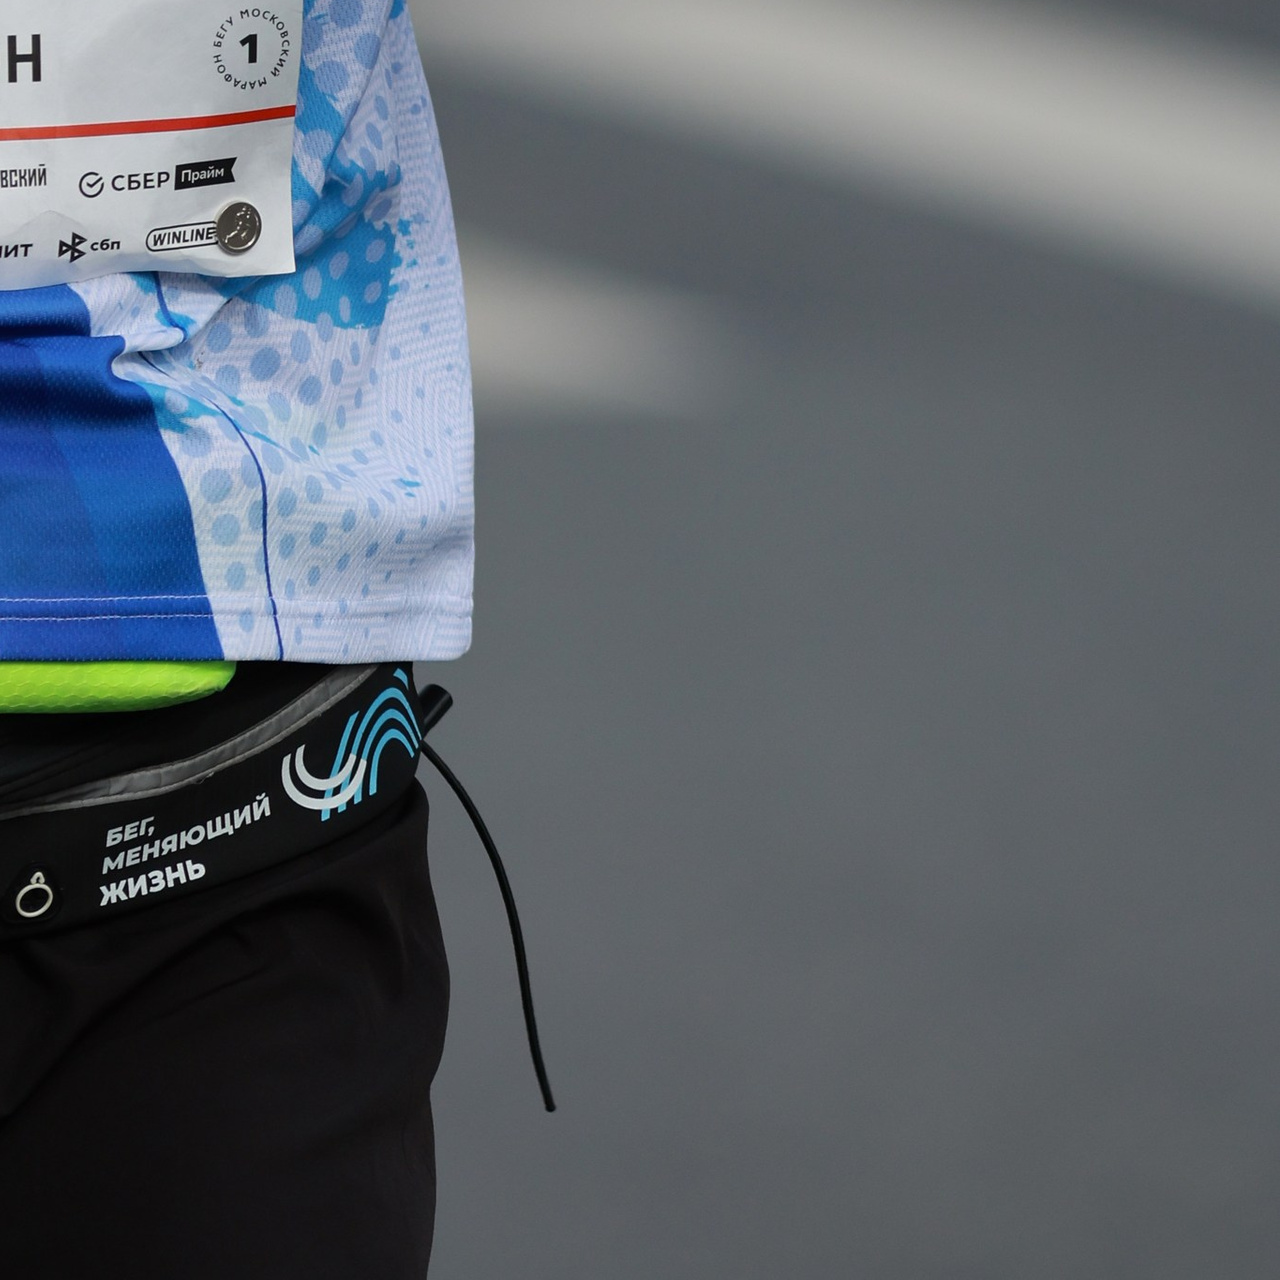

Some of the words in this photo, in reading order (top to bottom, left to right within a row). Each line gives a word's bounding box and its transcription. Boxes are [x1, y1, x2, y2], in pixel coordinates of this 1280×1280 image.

[213, 16, 234, 48] БЕГУ
[239, 8, 290, 77] МОСКОВСКИЙ
[239, 33, 258, 64] 1
[213, 54, 267, 90] МАРАФОН
[111, 171, 170, 191] СБЕР
[181, 166, 225, 183] Прайм
[90, 238, 121, 251] сбп
[152, 226, 218, 247] WINLINE
[102, 792, 271, 875] МЕНЯЮЩИЙ
[106, 816, 155, 847] БЕГ,
[99, 859, 206, 907] ЖИЗНЬ
